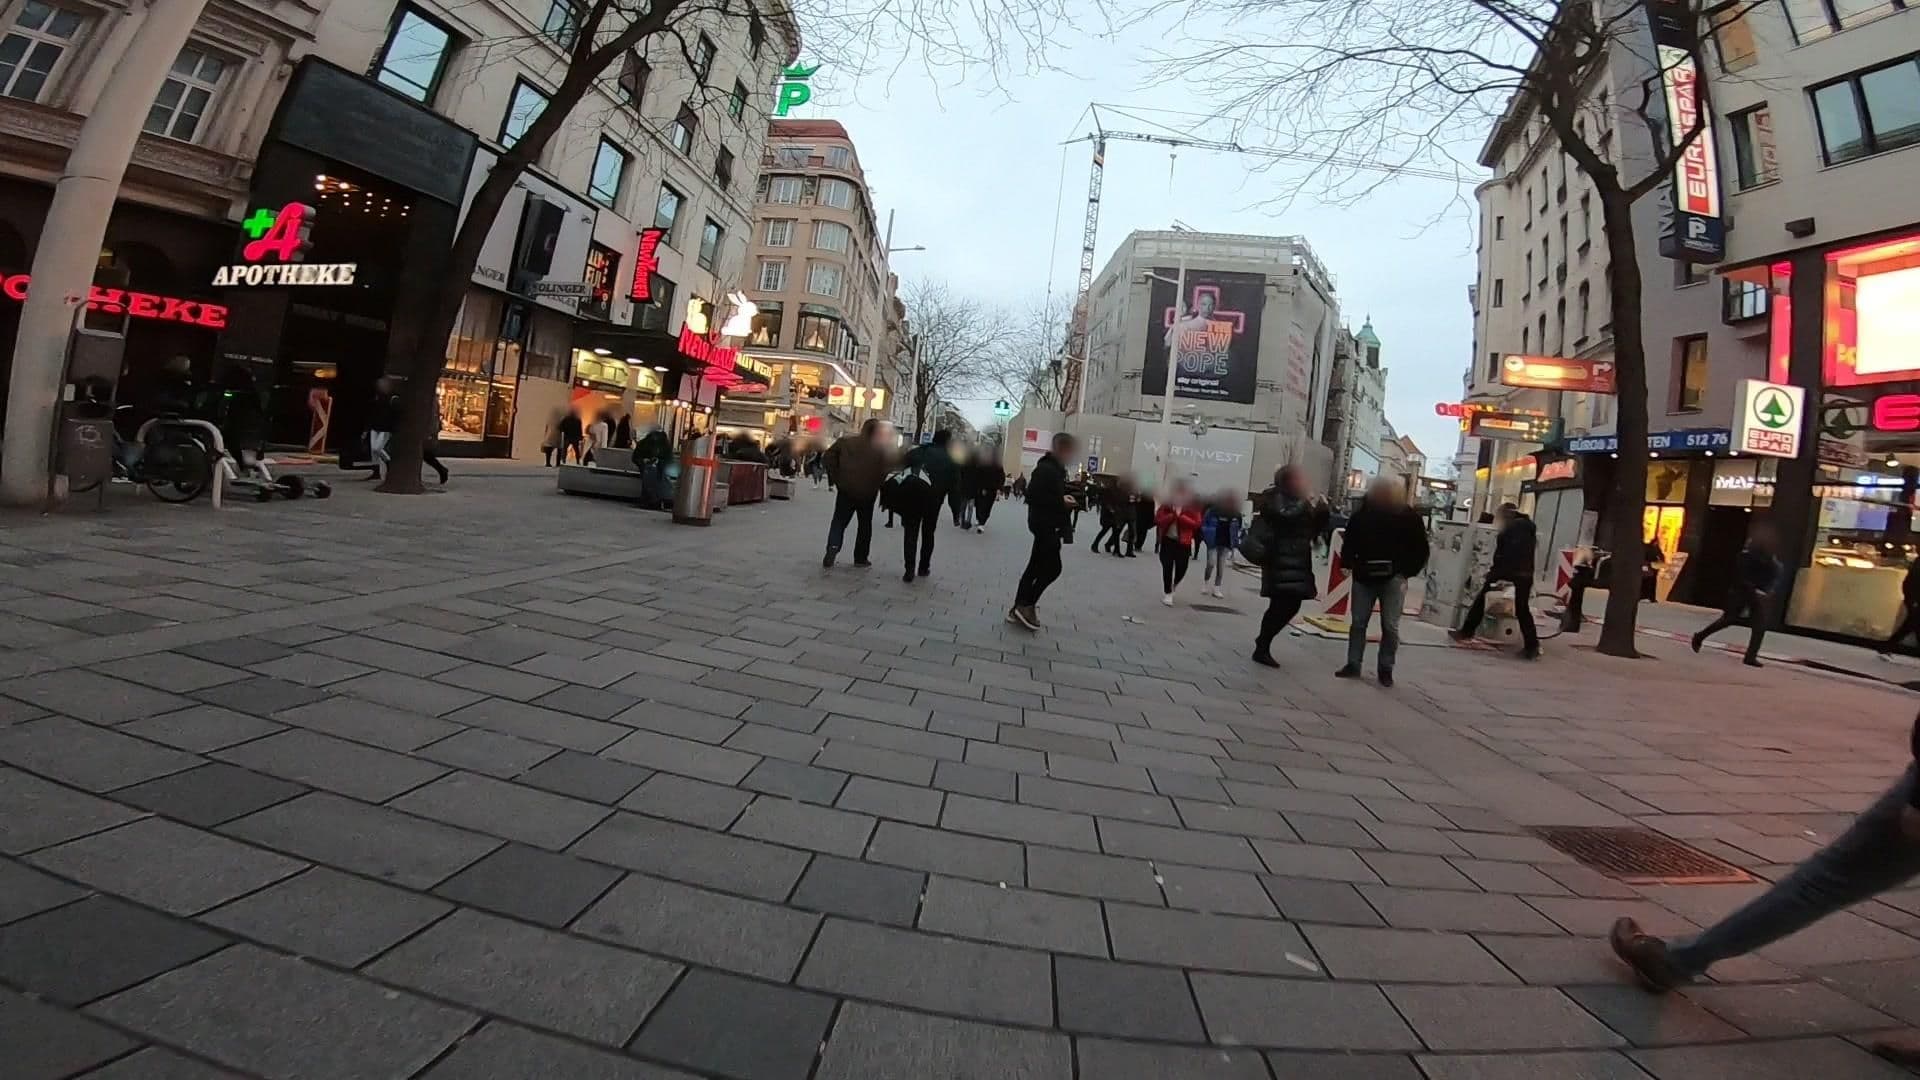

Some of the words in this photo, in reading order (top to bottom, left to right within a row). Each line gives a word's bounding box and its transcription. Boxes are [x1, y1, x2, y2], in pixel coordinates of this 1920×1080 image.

[776, 82, 811, 117] P
[1672, 66, 1707, 199] EURSPAR
[211, 263, 357, 287] APOTHEKE
[0, 273, 228, 328] OHEKE
[1179, 331, 1232, 353] NEW
[1686, 434, 1708, 446] 512
[1711, 433, 1728, 445] 76
[1748, 438, 1792, 454] SPAR
[1749, 429, 1793, 444] EURO
[1143, 441, 1244, 464] WRTINVEST
